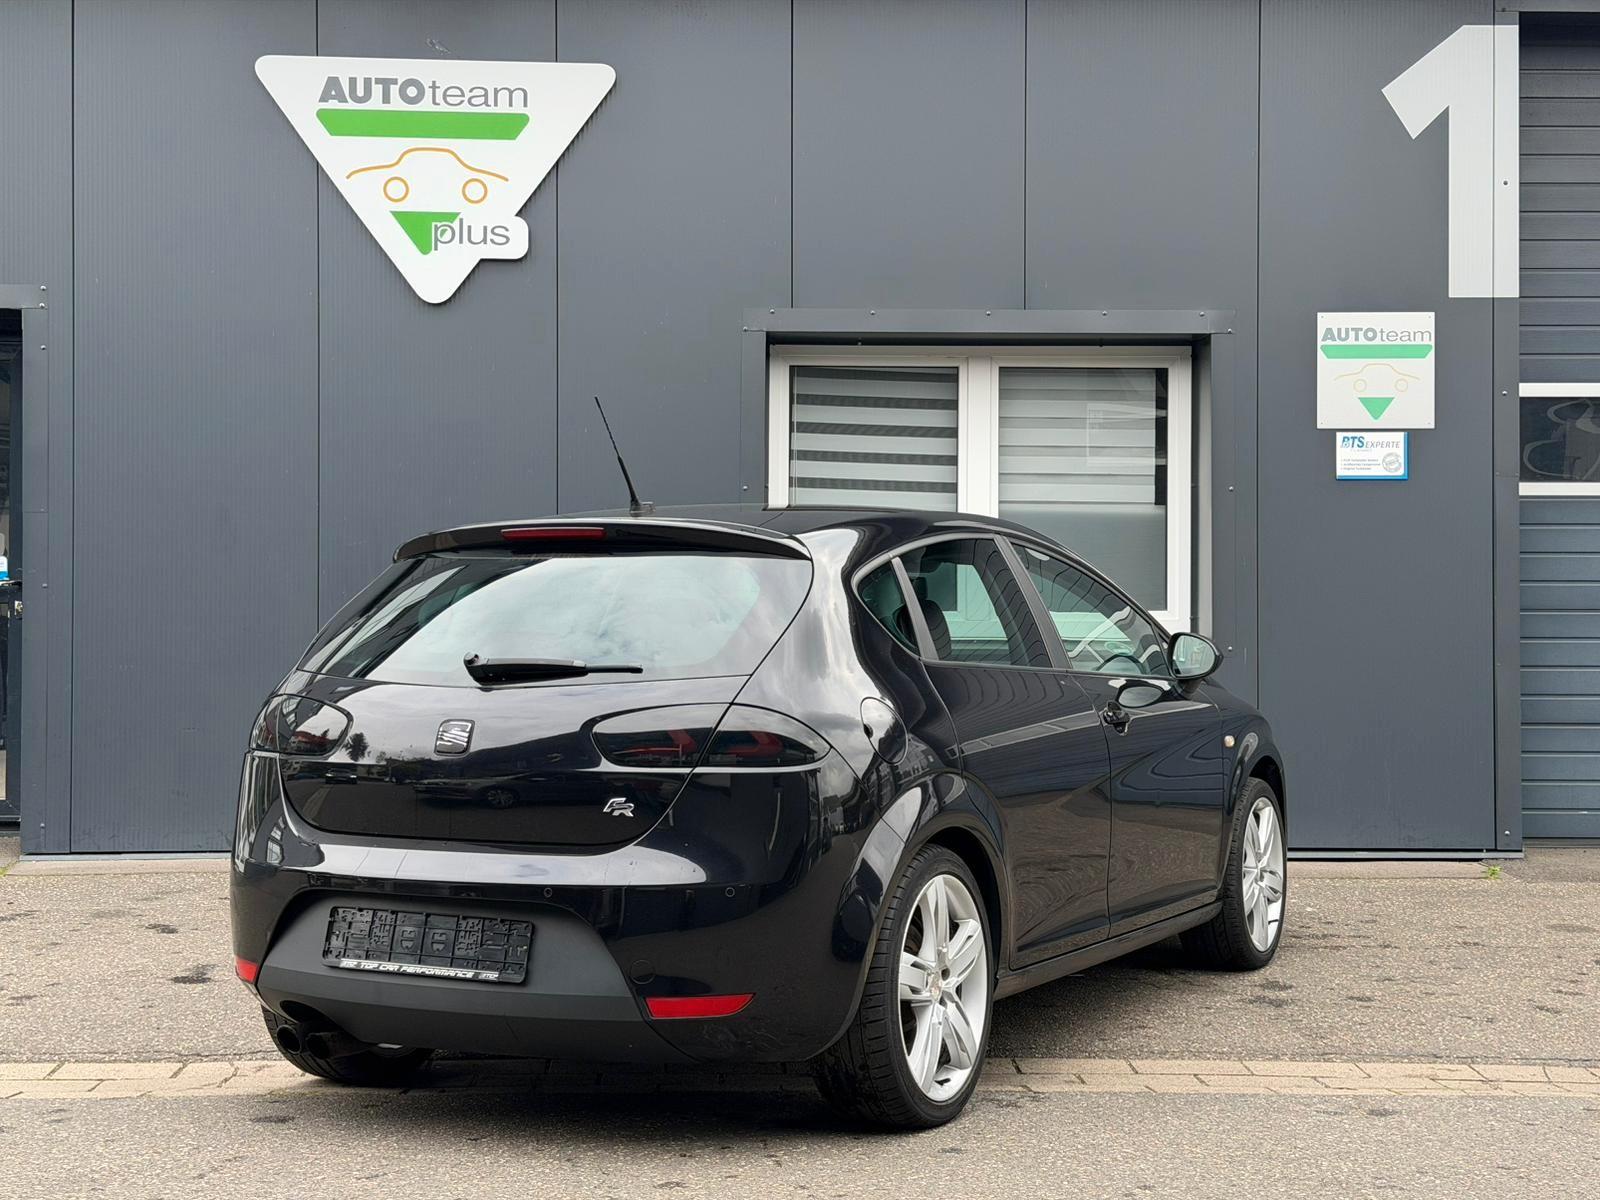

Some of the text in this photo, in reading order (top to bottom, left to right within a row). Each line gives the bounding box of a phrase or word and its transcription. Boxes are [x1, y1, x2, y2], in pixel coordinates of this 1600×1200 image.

[318, 76, 528, 108] AUTOteam
[1382, 25, 1520, 298] 1
[433, 218, 511, 251] plus
[1321, 327, 1432, 343] AUTOteam
[1365, 441, 1400, 449] EXPERTE
[400, 965, 475, 979] PERFORMANCE
